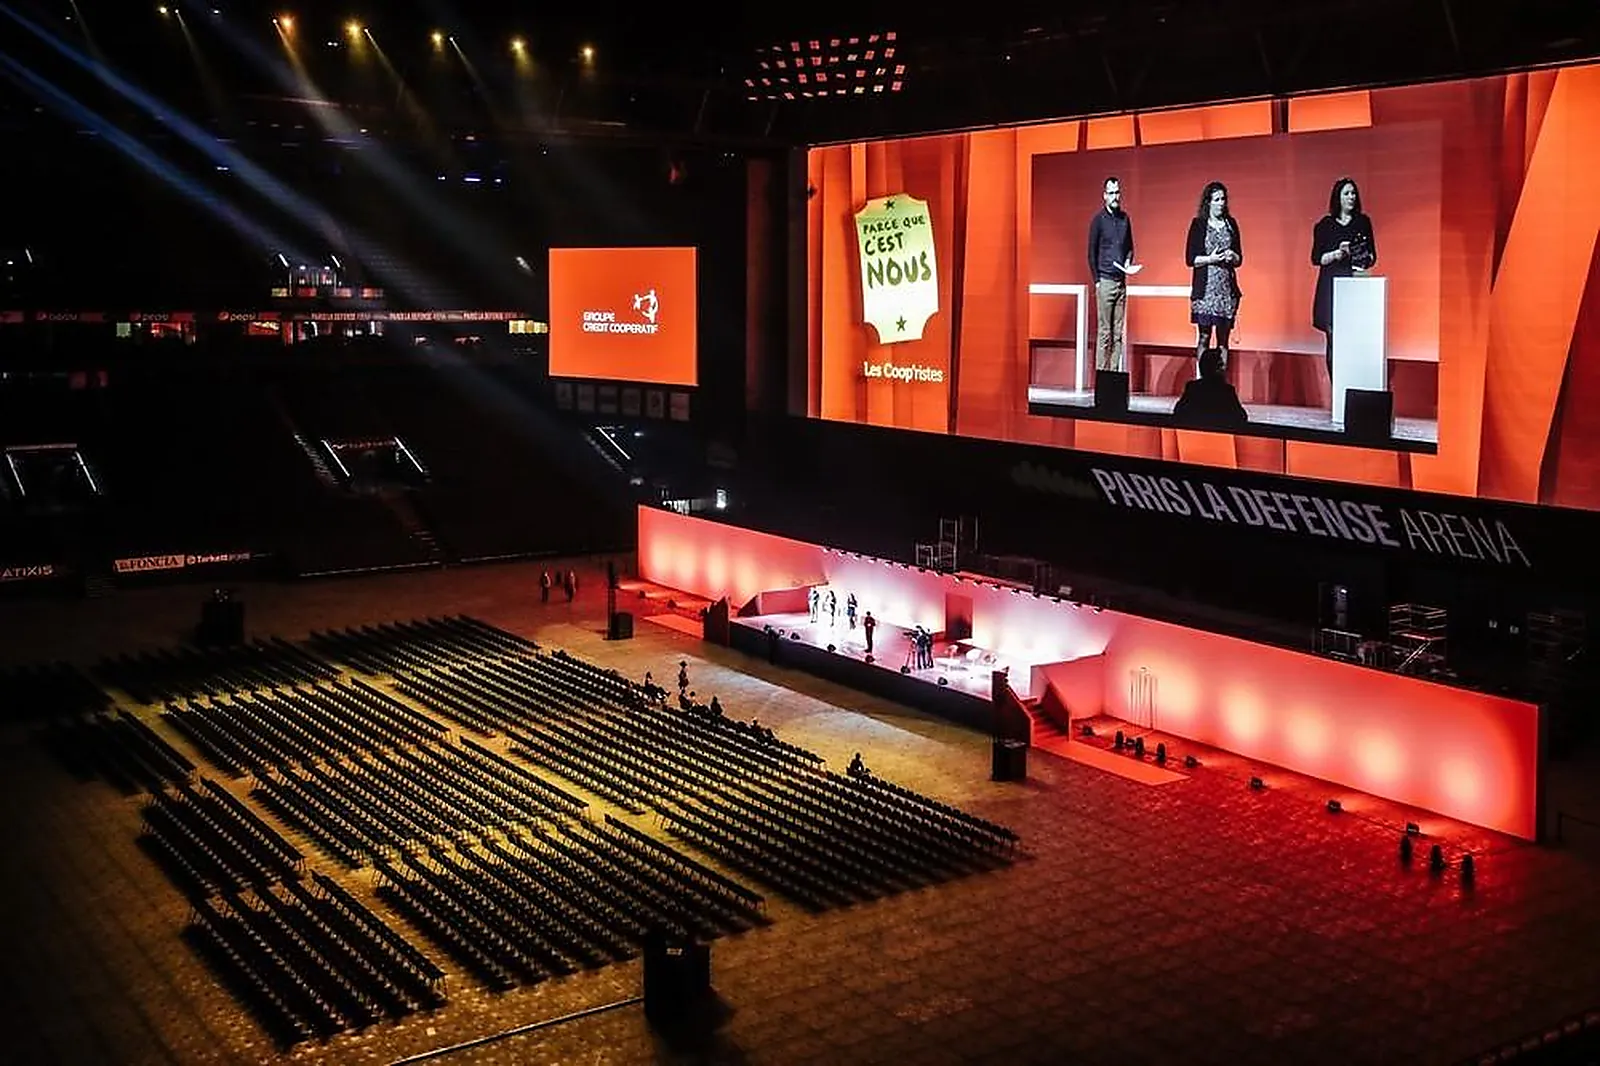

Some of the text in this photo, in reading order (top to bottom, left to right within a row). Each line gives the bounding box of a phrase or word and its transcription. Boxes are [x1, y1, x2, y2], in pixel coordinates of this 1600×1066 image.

[863, 215, 926, 234] PARCE QUE
[864, 232, 904, 256] C'EST
[867, 251, 932, 288] NOUS
[229, 312, 256, 321] pepsi
[583, 311, 616, 322] GROUPE
[583, 322, 659, 334] CREDIT COOPERATIF
[864, 361, 944, 382] Les Coop'ristes
[1091, 467, 1191, 517] PARIS
[1182, 480, 1239, 524] LA
[1231, 486, 1401, 547] DEFENSE
[1400, 508, 1532, 568] ARENA
[129, 556, 180, 571] FONCIA
